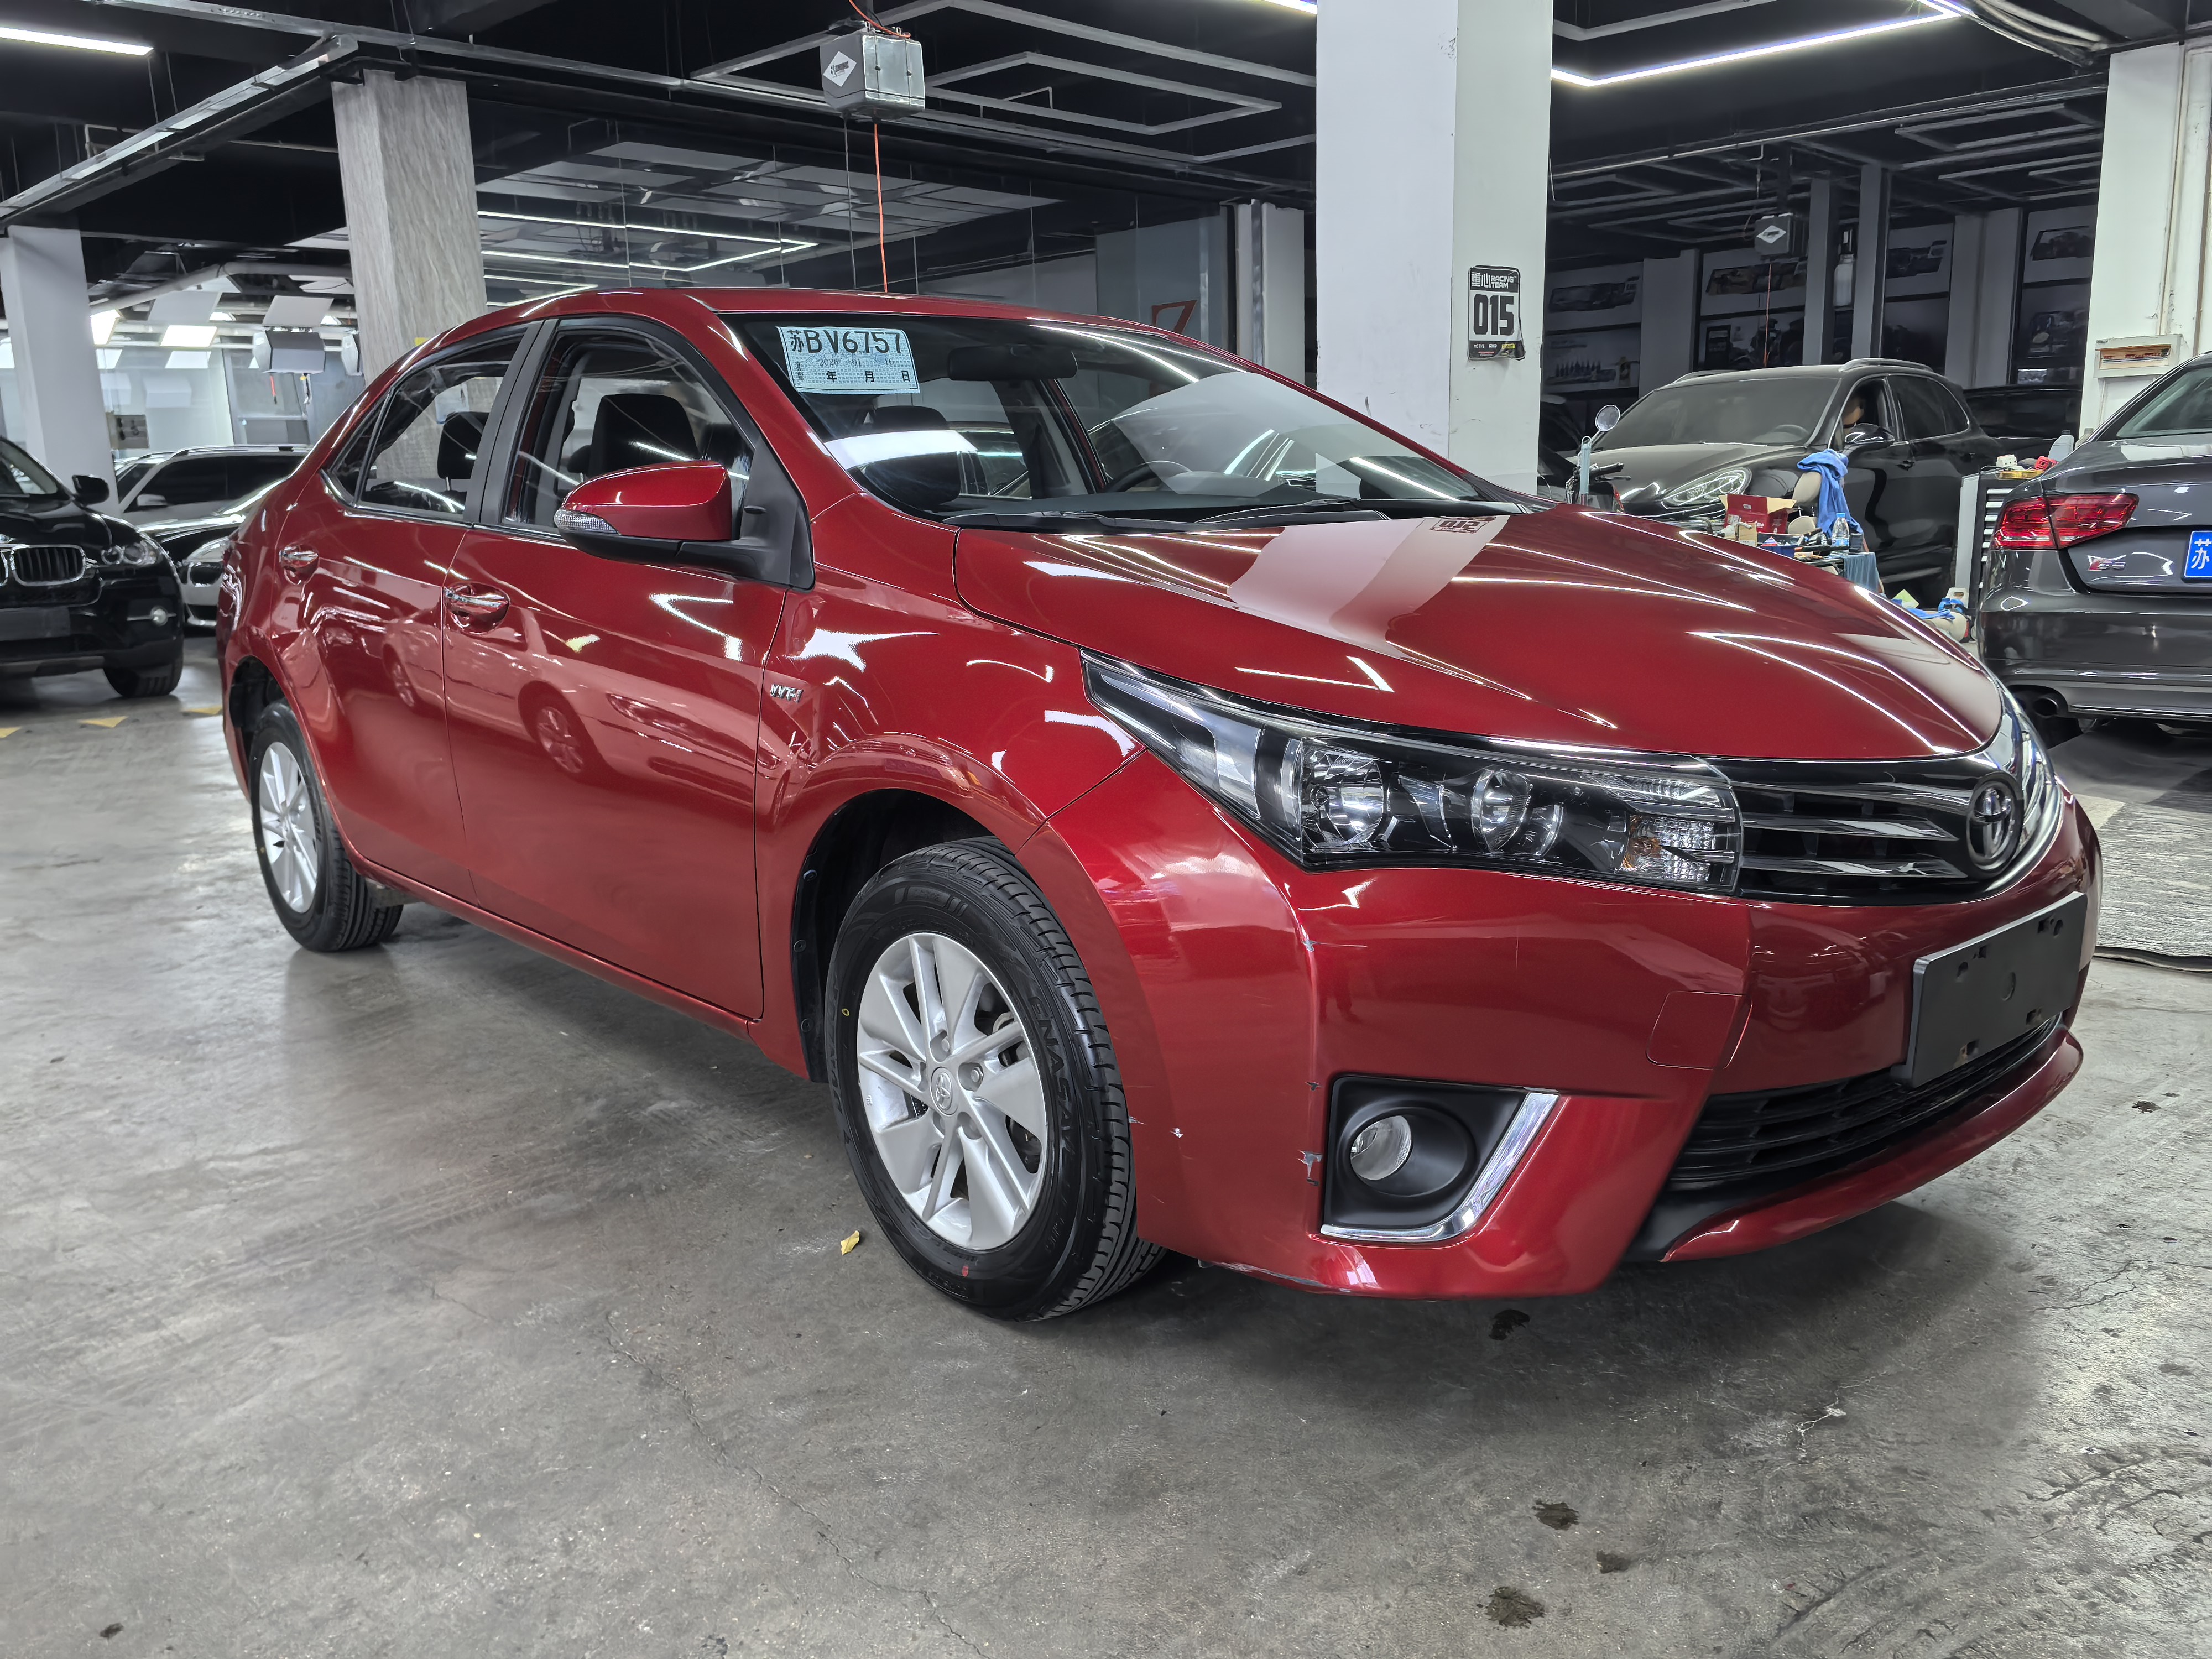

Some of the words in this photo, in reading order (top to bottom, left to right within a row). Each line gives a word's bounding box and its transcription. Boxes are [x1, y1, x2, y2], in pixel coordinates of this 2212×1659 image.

[1473, 294, 1515, 336] 015
[787, 329, 901, 354] 苏BV6757
[826, 371, 837, 382] 年
[865, 371, 875, 383] 月
[902, 370, 911, 382] 日
